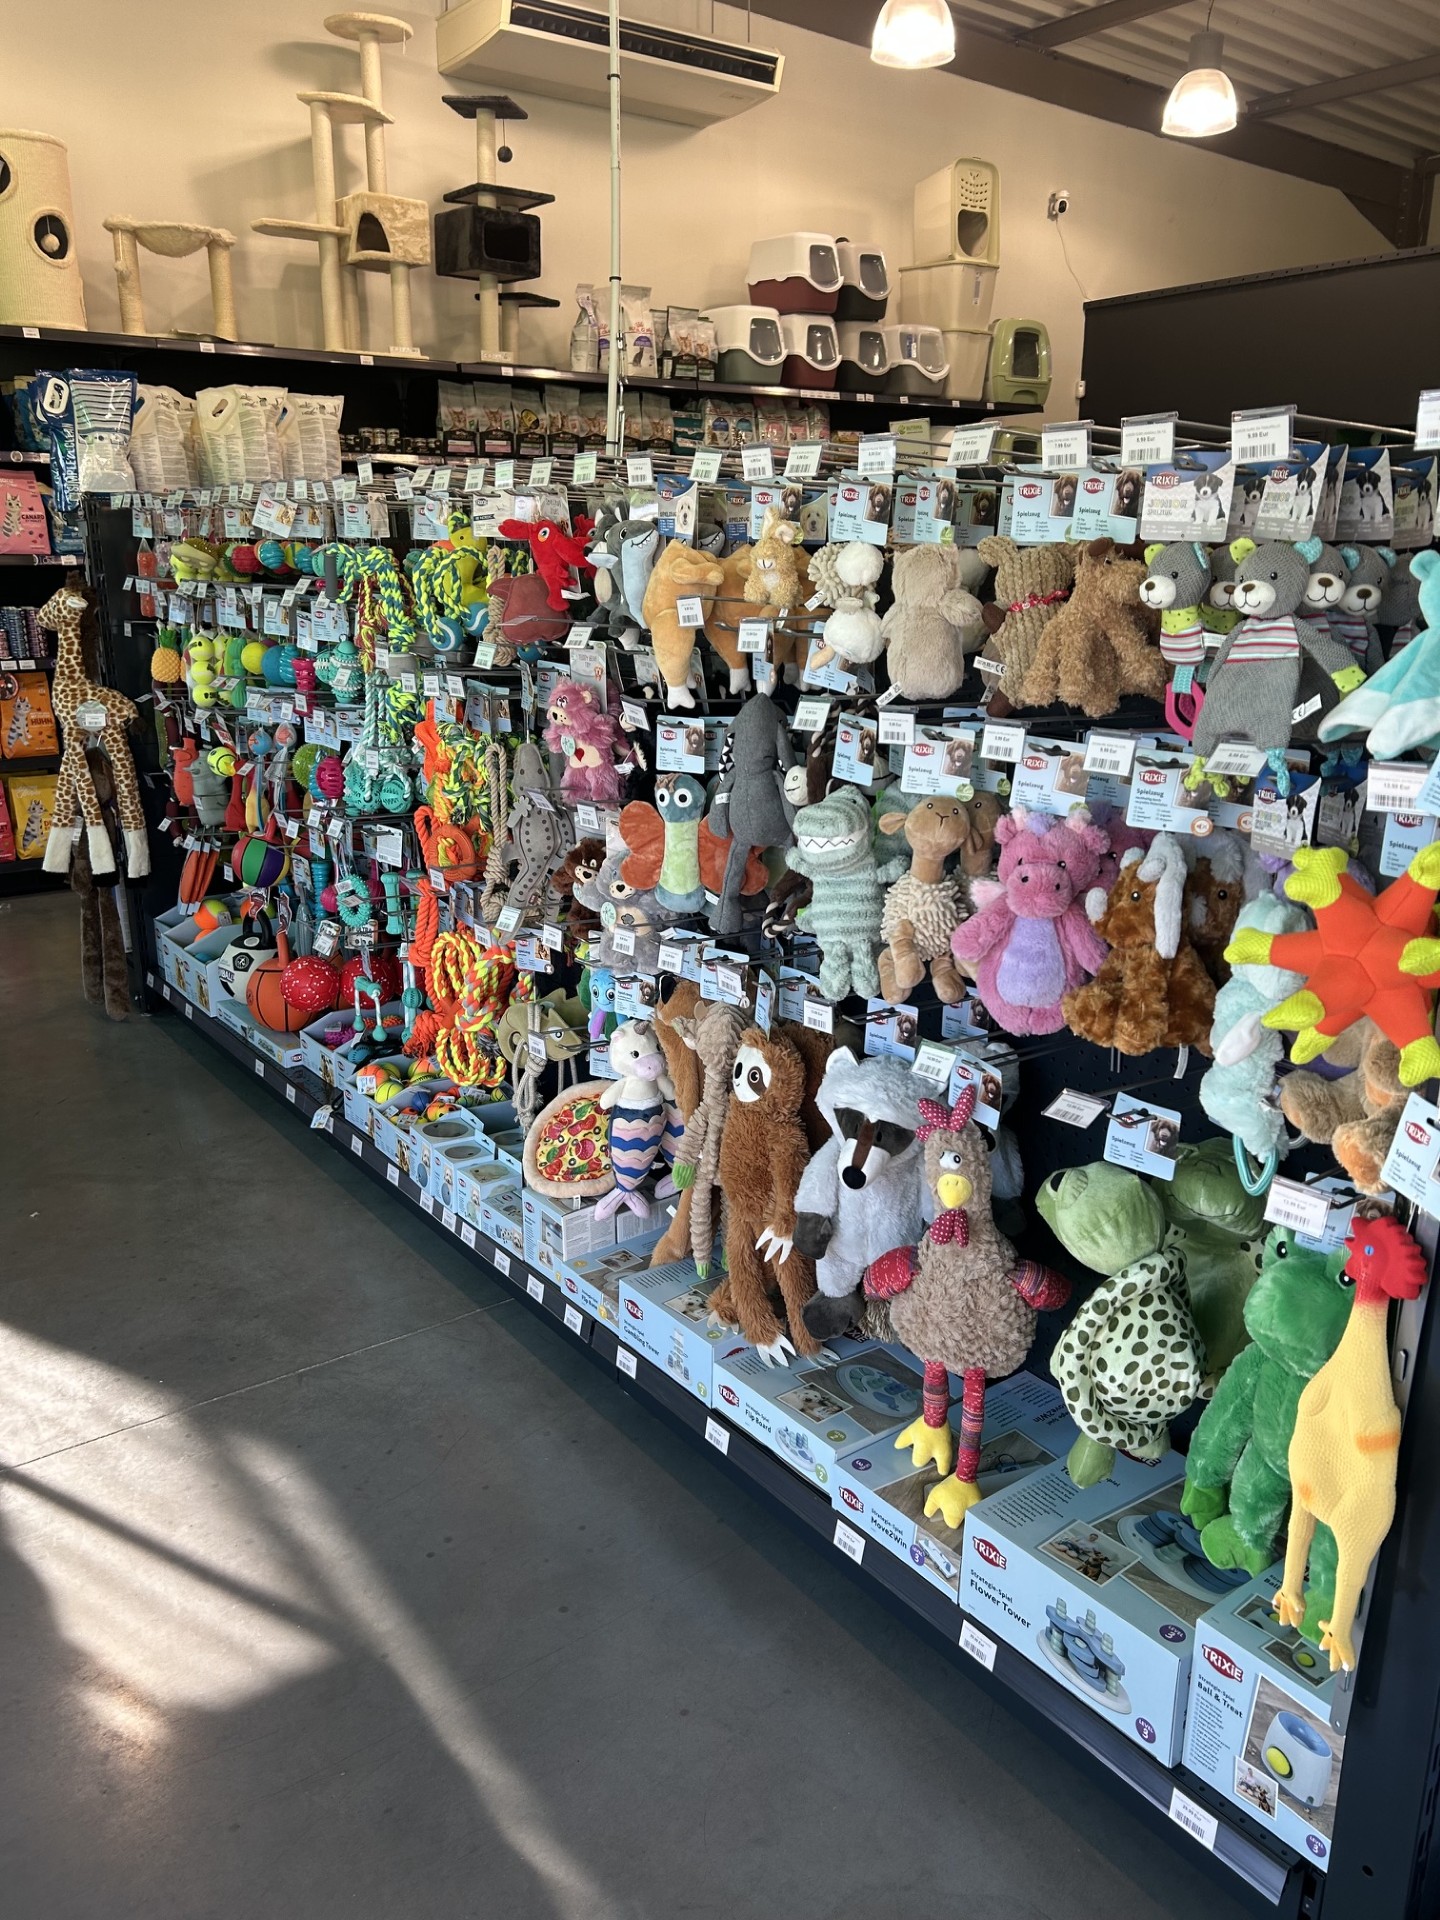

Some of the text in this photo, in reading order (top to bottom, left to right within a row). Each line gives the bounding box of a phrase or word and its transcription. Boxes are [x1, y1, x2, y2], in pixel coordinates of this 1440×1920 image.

[1078, 507, 1101, 515] Spielzeug
[908, 766, 932, 774] Spielzeug
[1018, 781, 1044, 790] Spielzeug
[1137, 788, 1164, 798] Spielzeug
[1389, 841, 1418, 853] Spielzeug
[1111, 1136, 1136, 1148] Spielzeug
[1395, 1149, 1422, 1171] Spielzeug
[623, 1325, 646, 1348] Gambling
[745, 1409, 772, 1433] Flip Board
[819, 1471, 824, 1480] 2
[870, 1516, 907, 1549] Move2Win
[914, 1552, 920, 1563] 3
[970, 1569, 1013, 1603] Strategie-Spiel
[970, 1579, 1031, 1629] Flower Tower
[1164, 1631, 1176, 1639] 3
[1198, 1674, 1236, 1703] Strategie-Spiel
[1197, 1681, 1244, 1719] Ball & Treat
[1138, 1719, 1154, 1734] LEVEL
[1141, 1728, 1149, 1739] 3
[1312, 1843, 1319, 1854] 3
